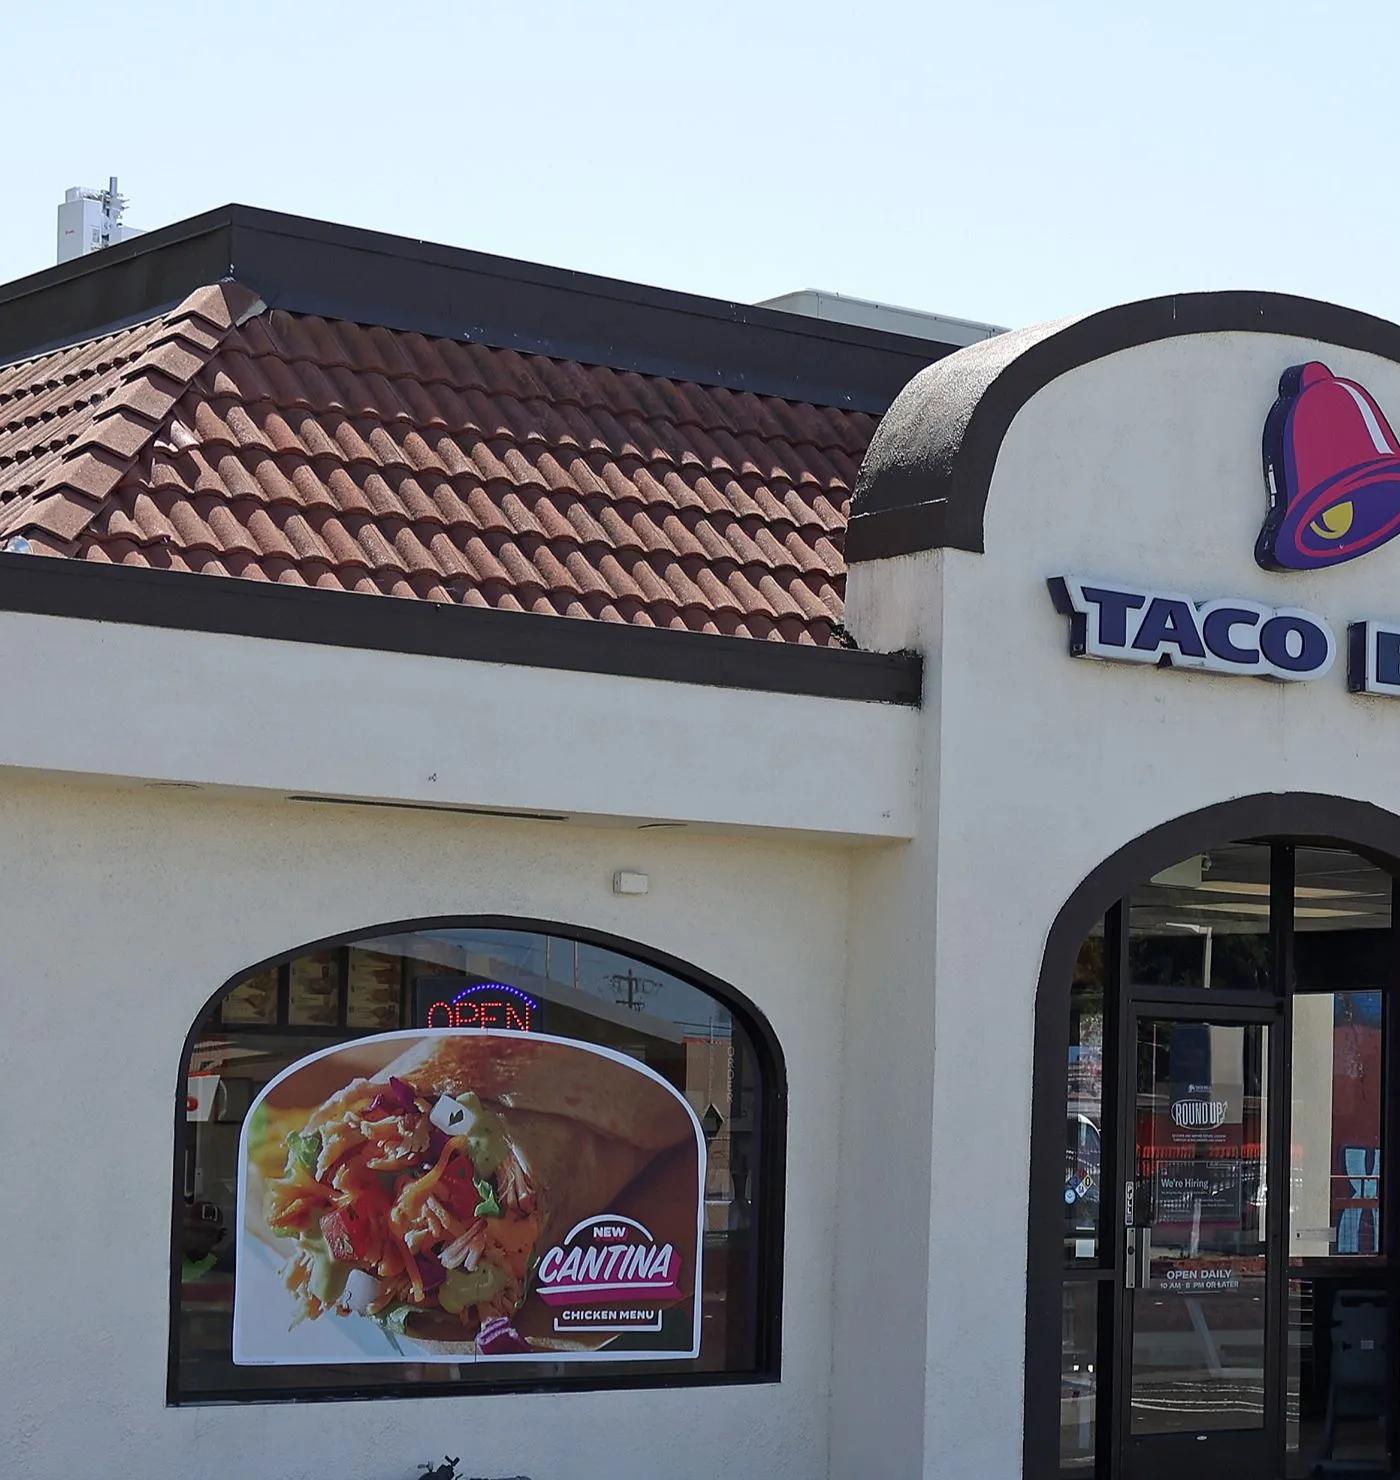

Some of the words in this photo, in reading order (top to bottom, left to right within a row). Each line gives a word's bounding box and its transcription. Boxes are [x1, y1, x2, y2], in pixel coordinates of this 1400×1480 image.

[1081, 585, 1329, 672] TACO
[427, 1001, 531, 1032] OPEN
[1175, 1102, 1208, 1126] ROUND
[1161, 1179, 1183, 1188] We're
[1184, 1179, 1209, 1189] Hiring
[593, 1227, 626, 1238] NEW
[538, 1243, 673, 1283] CANTINA
[1166, 1270, 1197, 1279] OPEN
[1200, 1269, 1232, 1279] DAILY
[1217, 1280, 1239, 1288] LATER
[562, 1310, 617, 1320] CHICKEN
[619, 1310, 654, 1320] MENU
